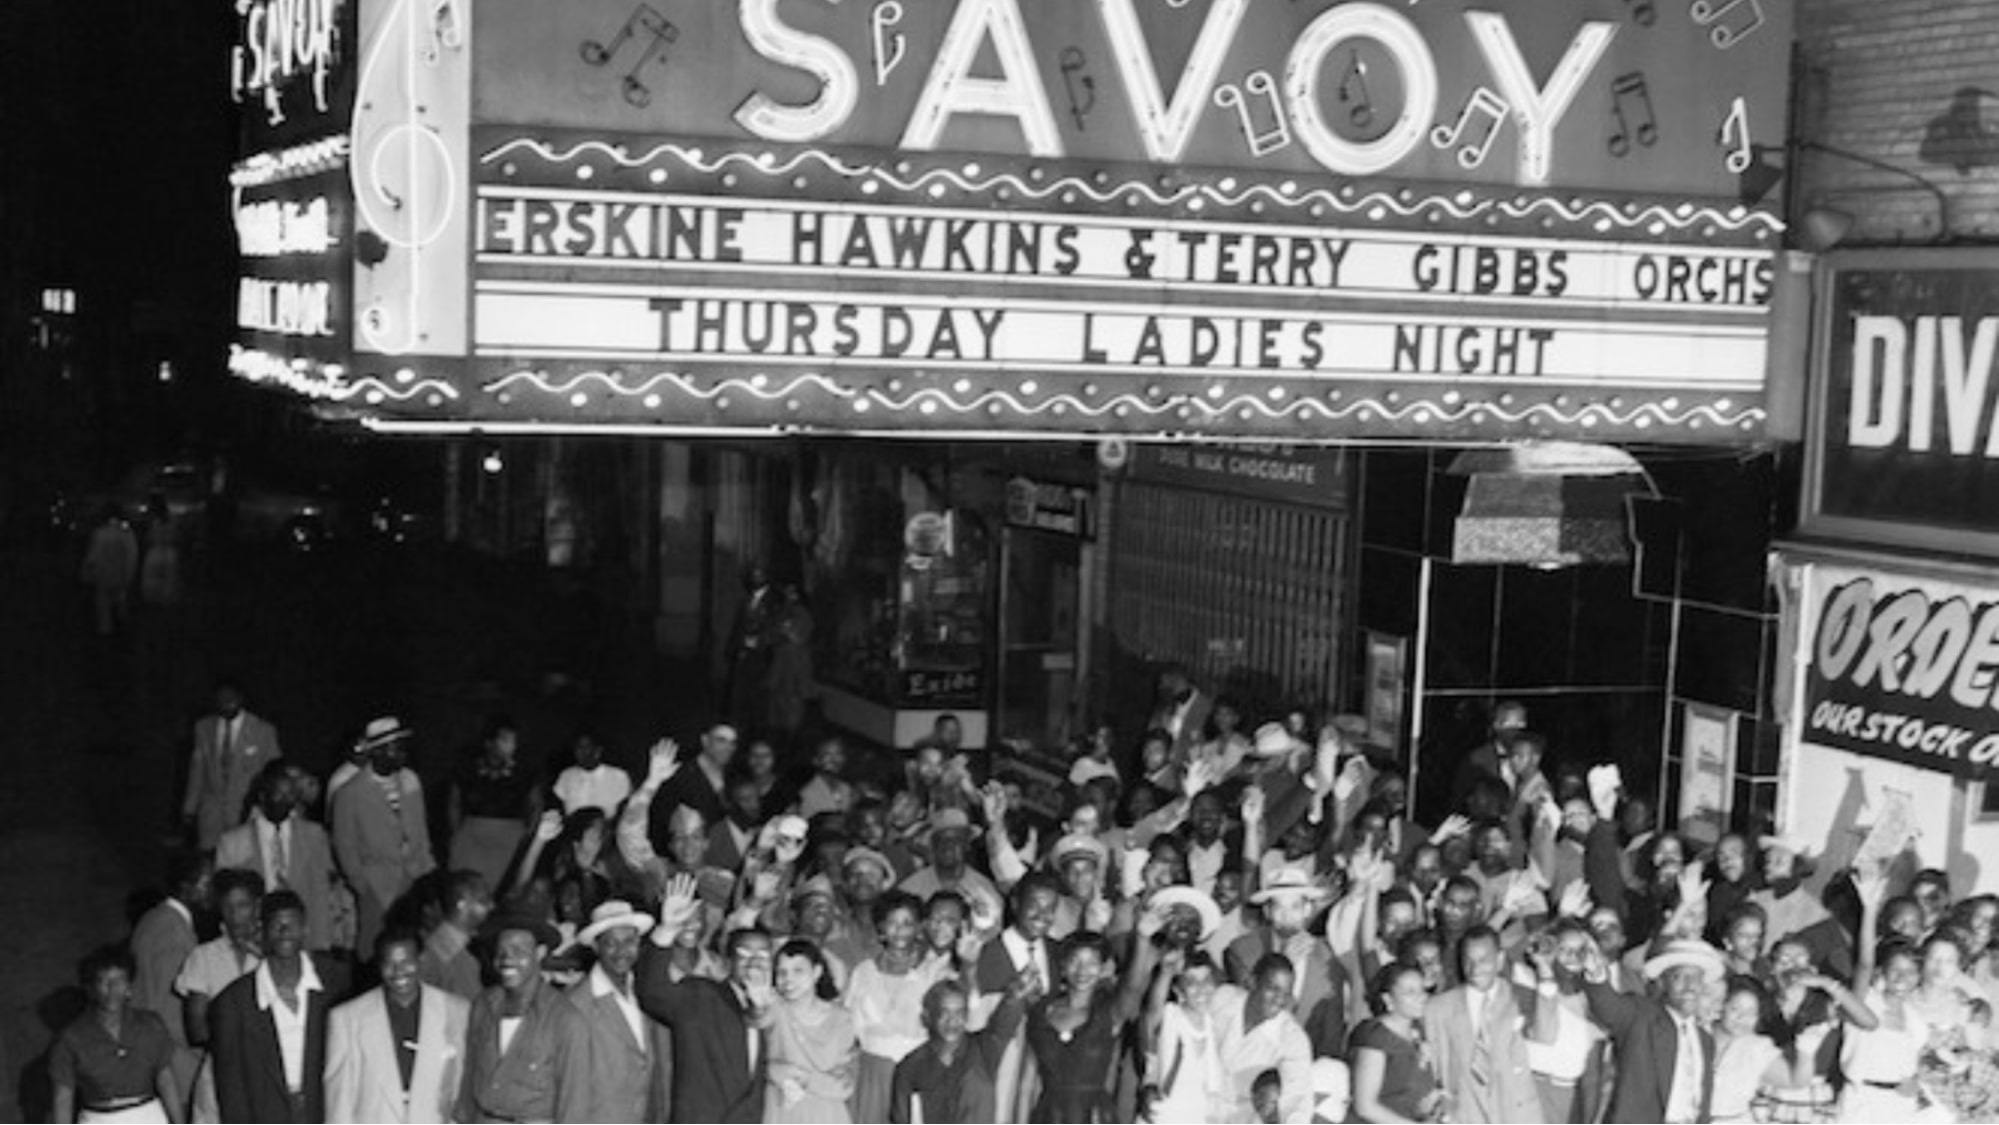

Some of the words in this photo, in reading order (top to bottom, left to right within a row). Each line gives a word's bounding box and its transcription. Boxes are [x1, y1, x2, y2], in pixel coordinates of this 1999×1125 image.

[733, 0, 1620, 186] SAVOY
[484, 203, 744, 261] ERSKINE
[794, 211, 1080, 274] HAWKINS
[1124, 229, 1156, 279] &
[1178, 233, 1352, 288] TERRY
[1413, 243, 1569, 296] GIBBS
[1633, 254, 1774, 303] ORCHS
[649, 299, 1006, 361] THURSDAY
[1081, 312, 1325, 370] LADIES
[1394, 324, 1555, 376] NIGHT
[1848, 315, 1999, 458] DIV
[1229, 456, 1315, 485] CHOCOLATE
[1813, 576, 1999, 711] ORDE
[1812, 701, 1864, 738] OUR
[1860, 713, 1972, 759] STOCK
[1968, 733, 1999, 767] O
